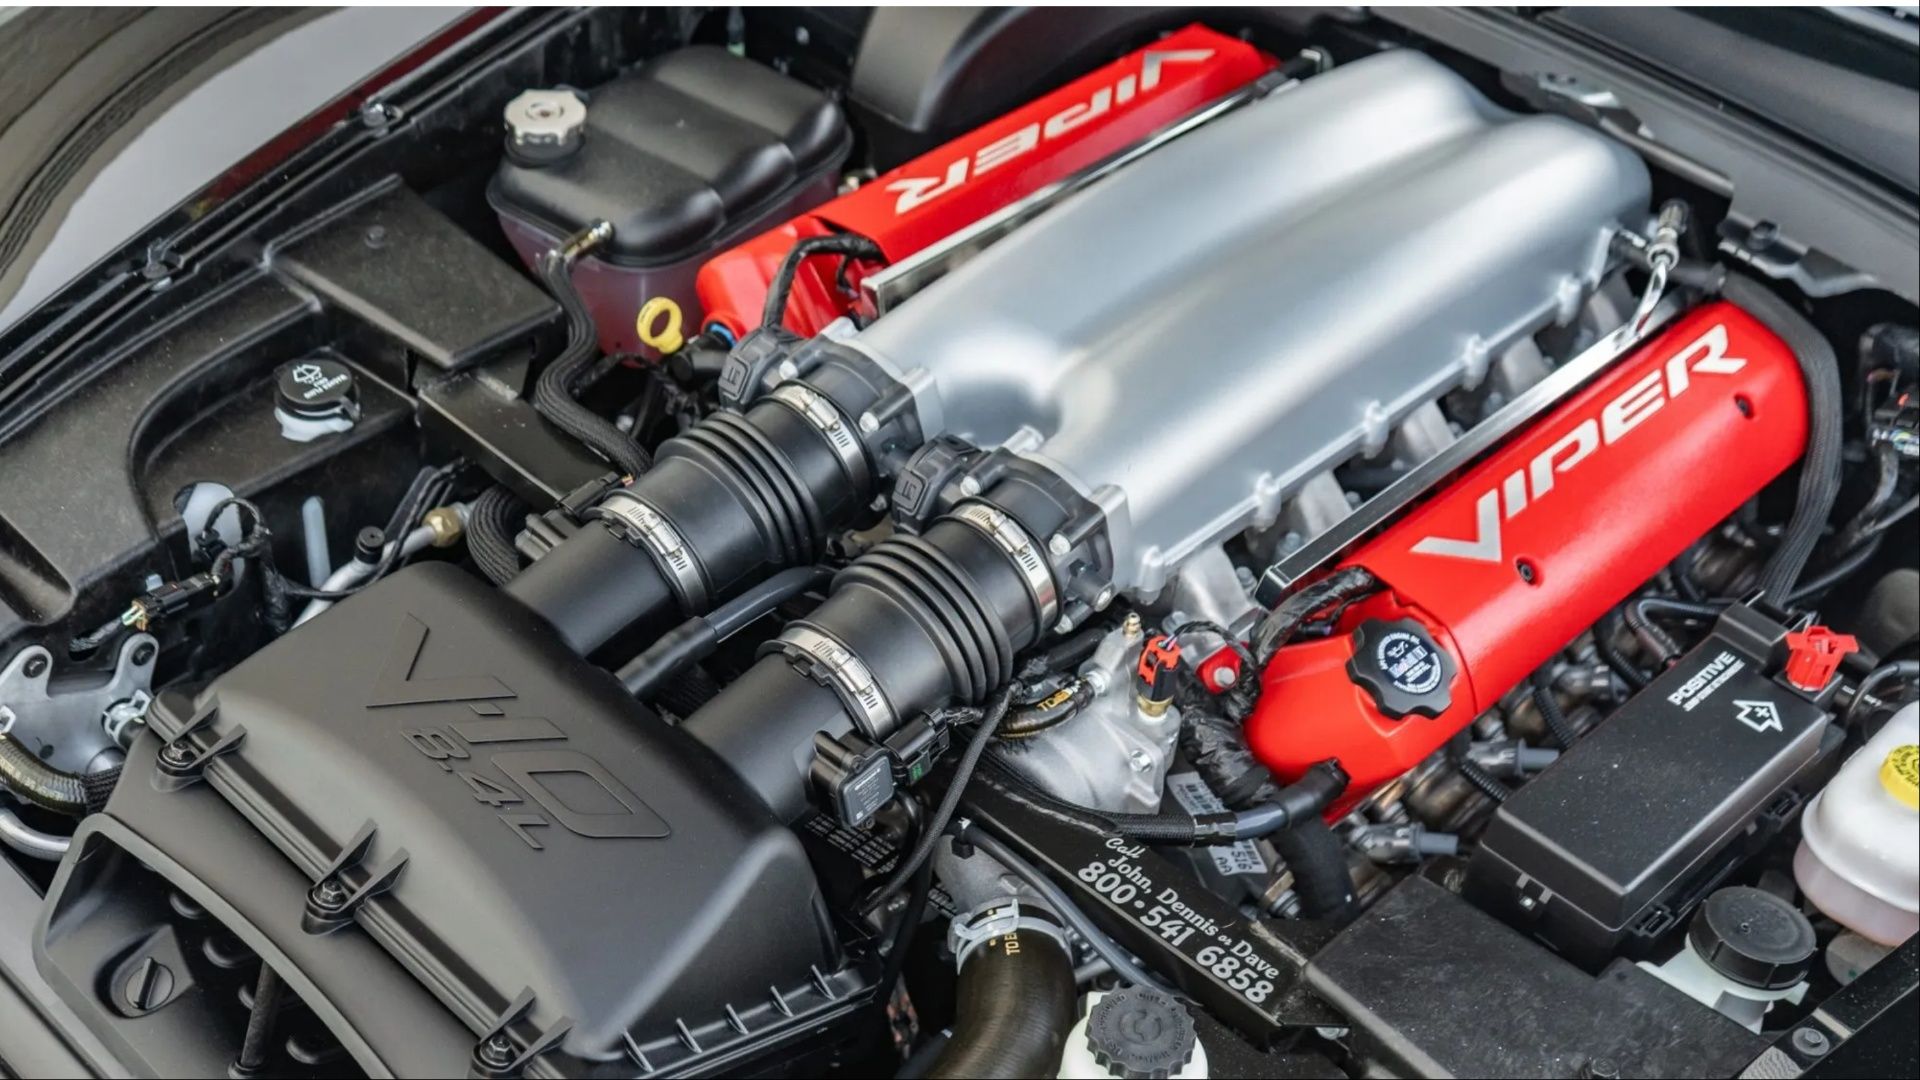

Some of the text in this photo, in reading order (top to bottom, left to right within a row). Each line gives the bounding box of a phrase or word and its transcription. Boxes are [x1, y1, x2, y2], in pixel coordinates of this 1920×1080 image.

[886, 47, 1217, 216] VIPER
[1408, 322, 1750, 563] VIPER
[1667, 650, 1737, 706] POSITIVE
[400, 727, 550, 851] 8.4L
[1105, 837, 1147, 859] Call
[1107, 855, 1280, 980] John, Dennis or Dave
[1195, 945, 1275, 1004] 6858
